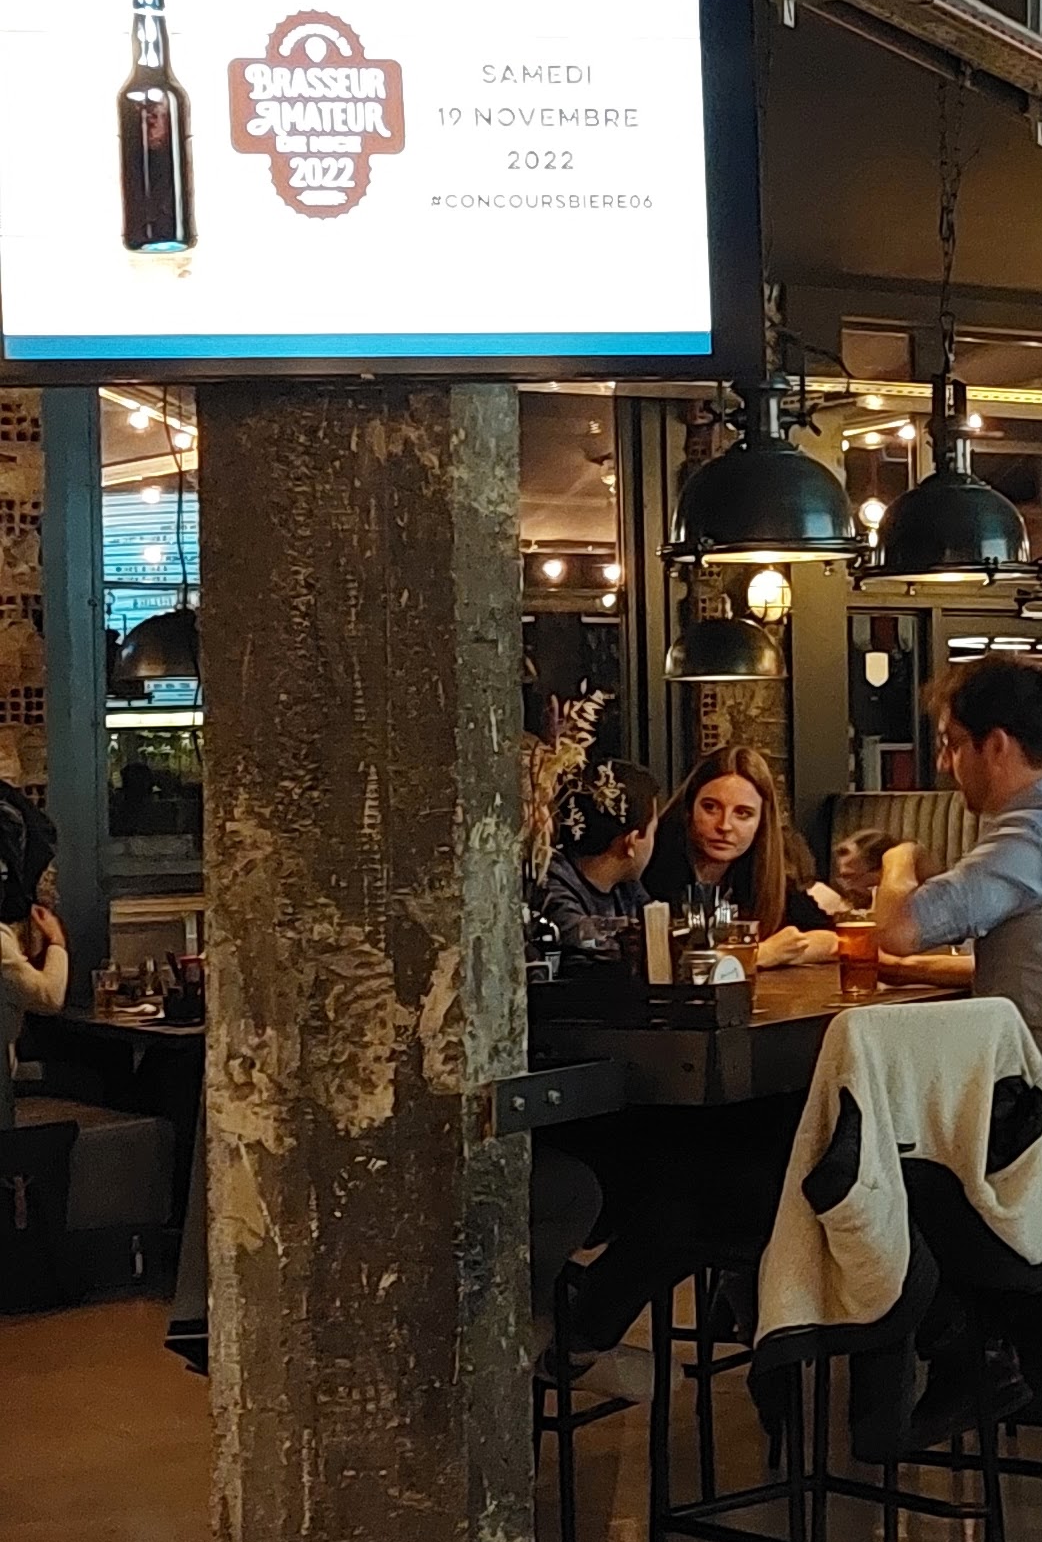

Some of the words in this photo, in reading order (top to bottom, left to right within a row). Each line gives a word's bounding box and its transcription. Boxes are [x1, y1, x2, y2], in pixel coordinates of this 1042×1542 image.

[244, 63, 387, 100] BRASSEUR
[482, 64, 591, 84] SAMEDI
[246, 100, 392, 139] AMATEUR
[438, 107, 462, 126] 19
[474, 107, 639, 127] NOVEMBRE
[507, 150, 574, 169] 2022
[288, 156, 356, 188] 2022
[431, 194, 653, 208] #CONCOURSBIERE06
